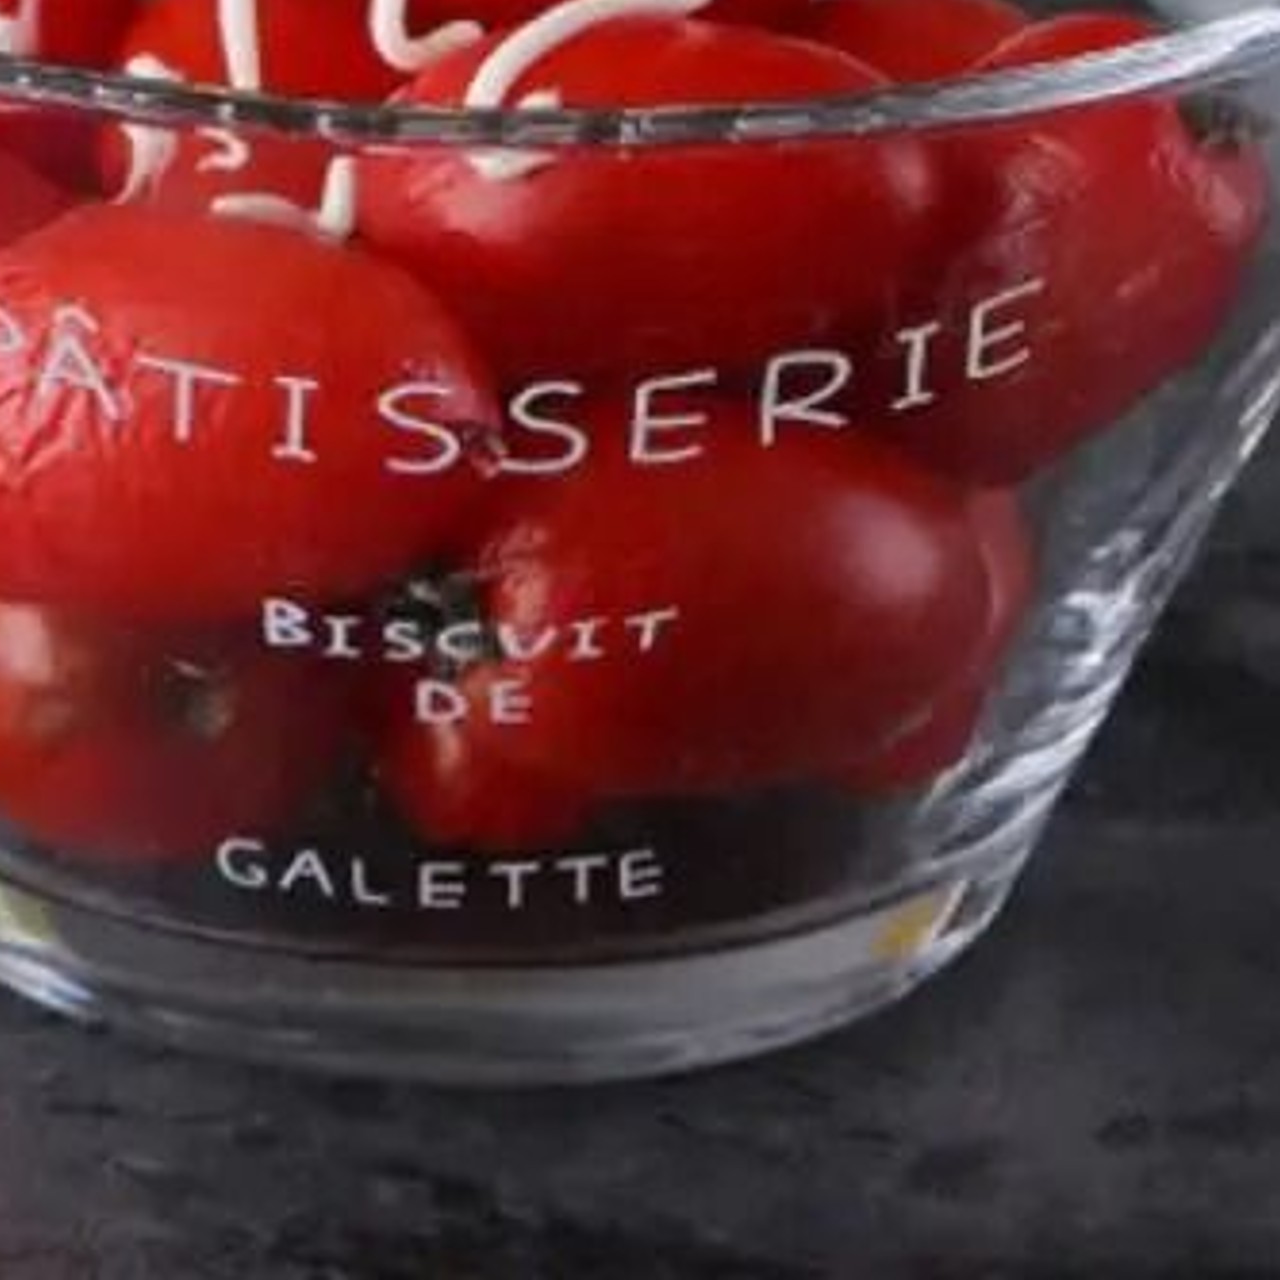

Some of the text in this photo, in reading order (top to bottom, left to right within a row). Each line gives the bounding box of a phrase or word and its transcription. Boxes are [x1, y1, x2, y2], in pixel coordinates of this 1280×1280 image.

[261, 595, 679, 665] BISCUIT
[413, 679, 536, 728] DE
[213, 834, 667, 912] GALETTE
